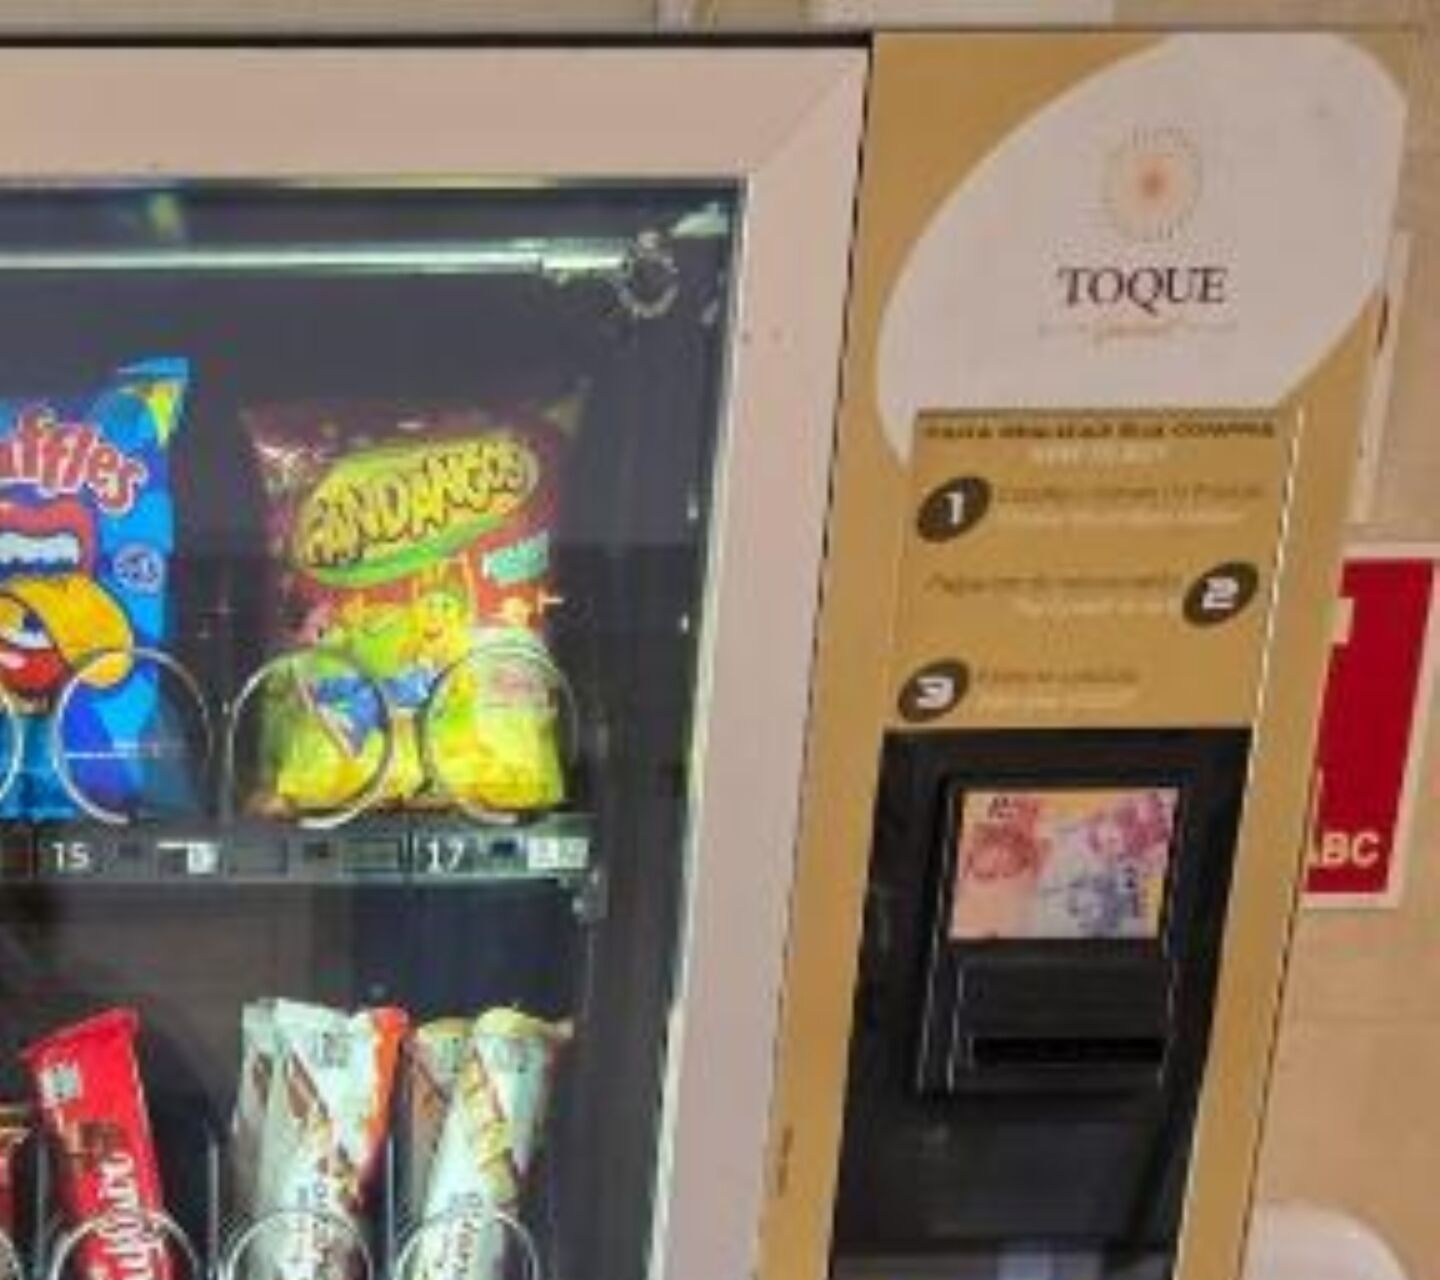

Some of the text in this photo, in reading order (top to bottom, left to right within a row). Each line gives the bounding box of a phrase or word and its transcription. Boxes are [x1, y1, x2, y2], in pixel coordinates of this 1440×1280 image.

[1056, 266, 1228, 316] TOQUE
[945, 491, 965, 525] 1
[1201, 576, 1241, 610] 2
[914, 674, 956, 709] 3
